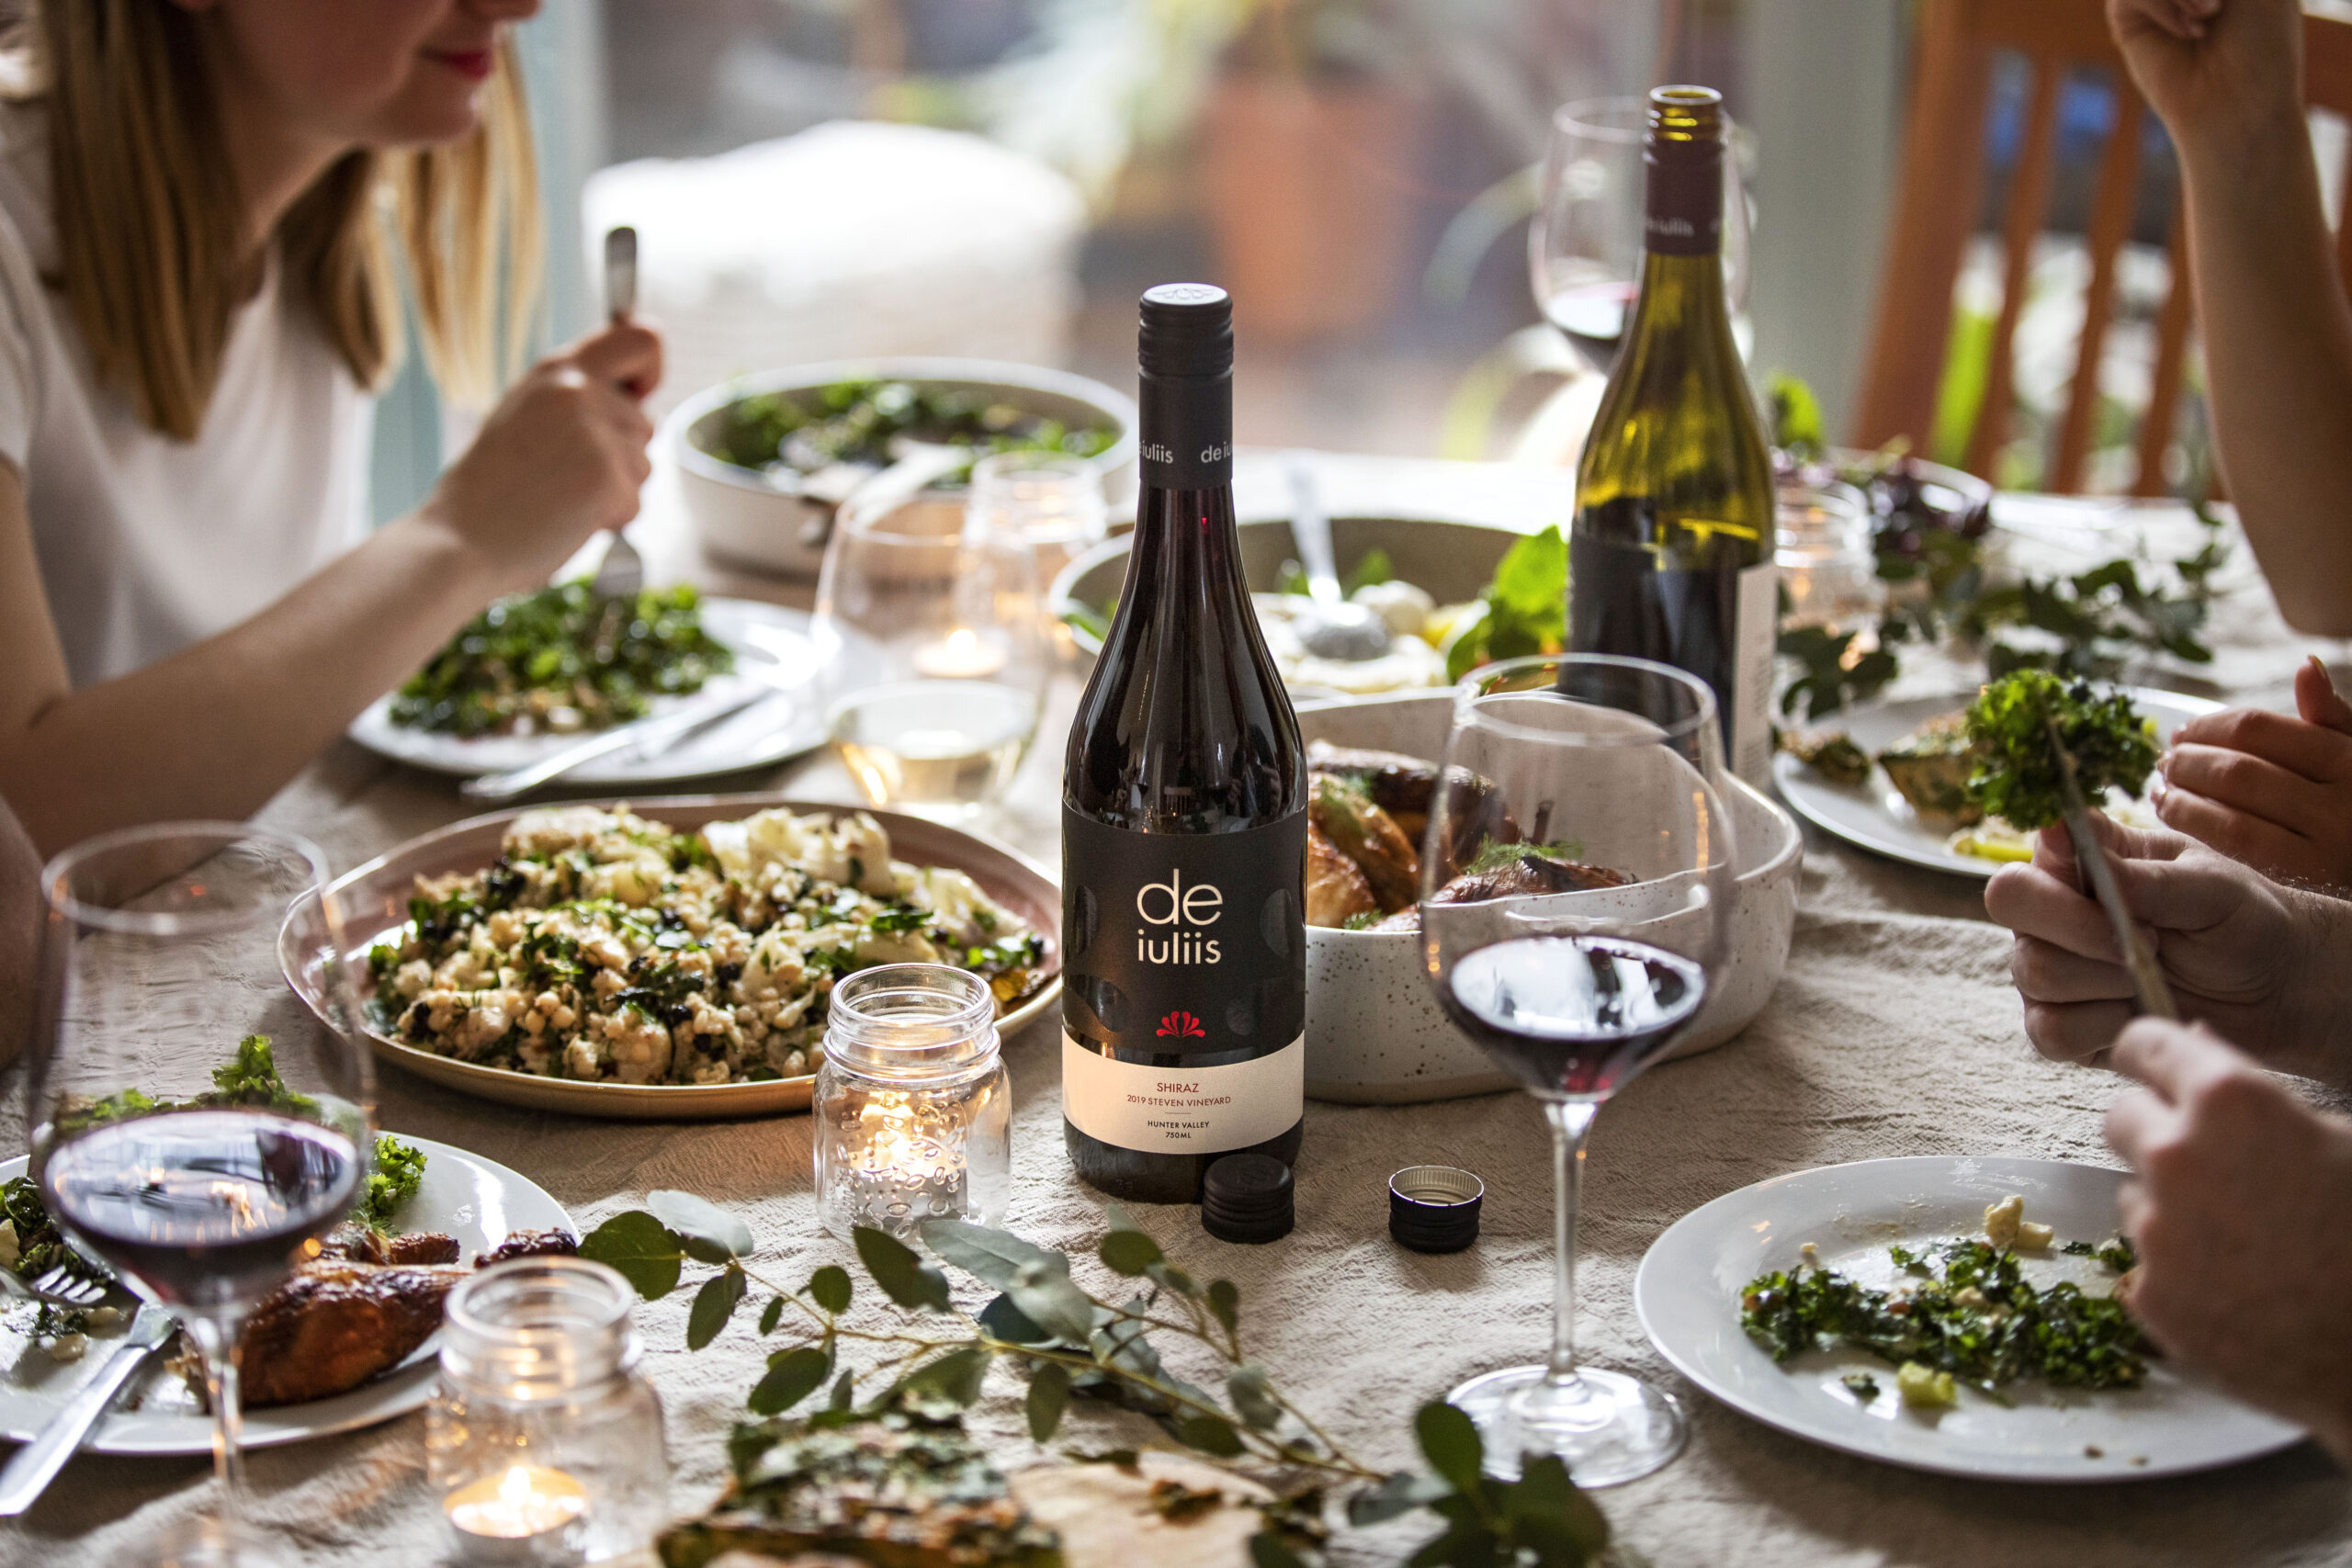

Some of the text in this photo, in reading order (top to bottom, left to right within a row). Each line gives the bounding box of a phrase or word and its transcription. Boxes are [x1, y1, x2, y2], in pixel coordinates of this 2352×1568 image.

[1201, 445, 1222, 463] de
[1136, 868, 1223, 926] de
[1137, 929, 1221, 964] iuliis
[1157, 1082, 1199, 1094] SHIRAZ
[1127, 1094, 1231, 1107] 2019 STEVEN VINEYARD
[1148, 1121, 1180, 1129] HUNTER
